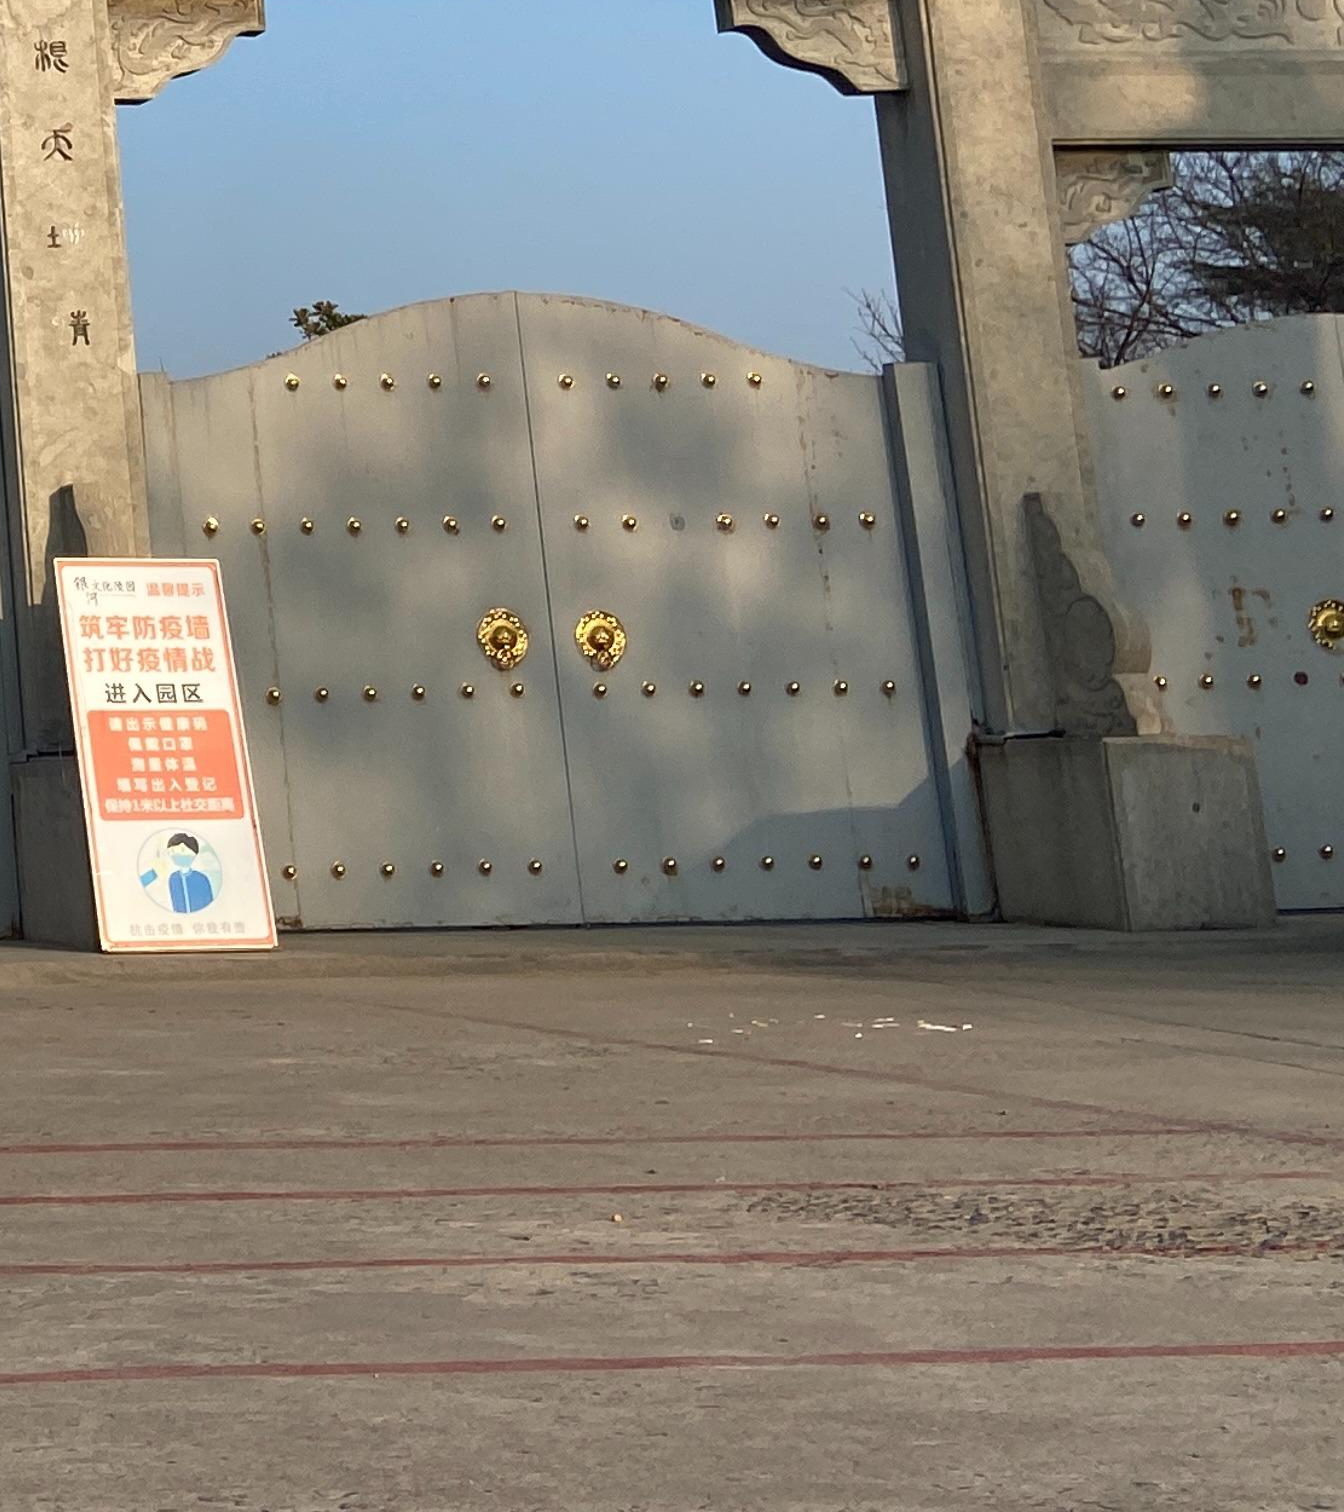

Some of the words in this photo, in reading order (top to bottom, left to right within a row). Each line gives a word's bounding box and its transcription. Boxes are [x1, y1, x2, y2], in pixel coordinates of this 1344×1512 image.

[79, 615, 210, 640] 筑牢防疫墙
[83, 646, 215, 672] 打好疫情战
[105, 683, 203, 704] 进入园区
[116, 776, 217, 792] 填写出入登记
